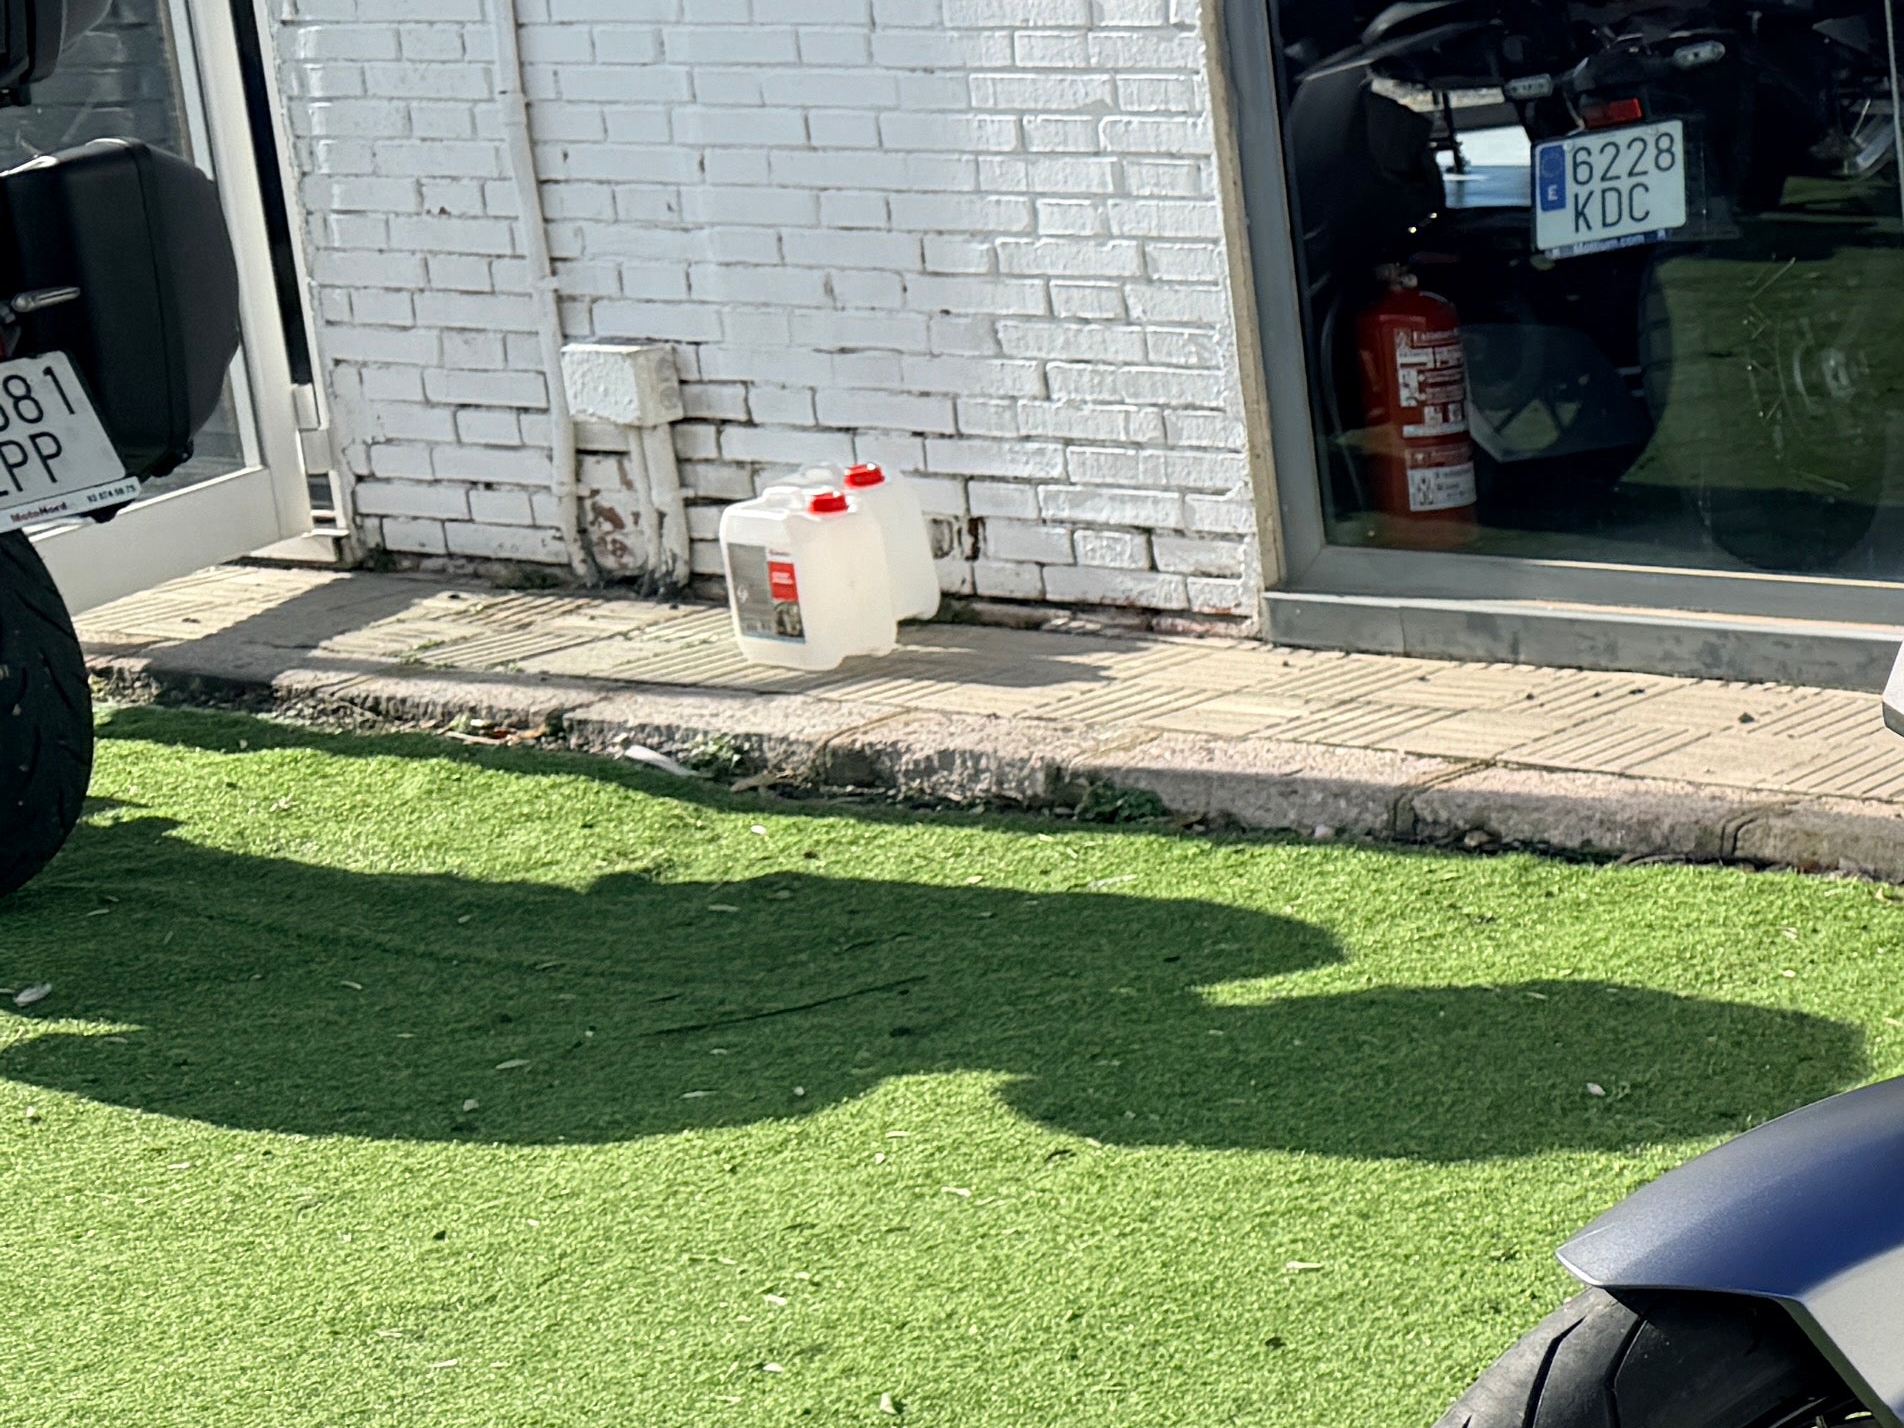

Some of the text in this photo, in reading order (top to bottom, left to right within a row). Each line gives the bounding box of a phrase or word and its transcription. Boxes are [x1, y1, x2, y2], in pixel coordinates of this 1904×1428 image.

[1572, 132, 1675, 185] 6228
[1547, 184, 1558, 201] E
[1574, 183, 1650, 233] KDC
[0, 366, 76, 432] 81
[0, 431, 62, 497] PP
